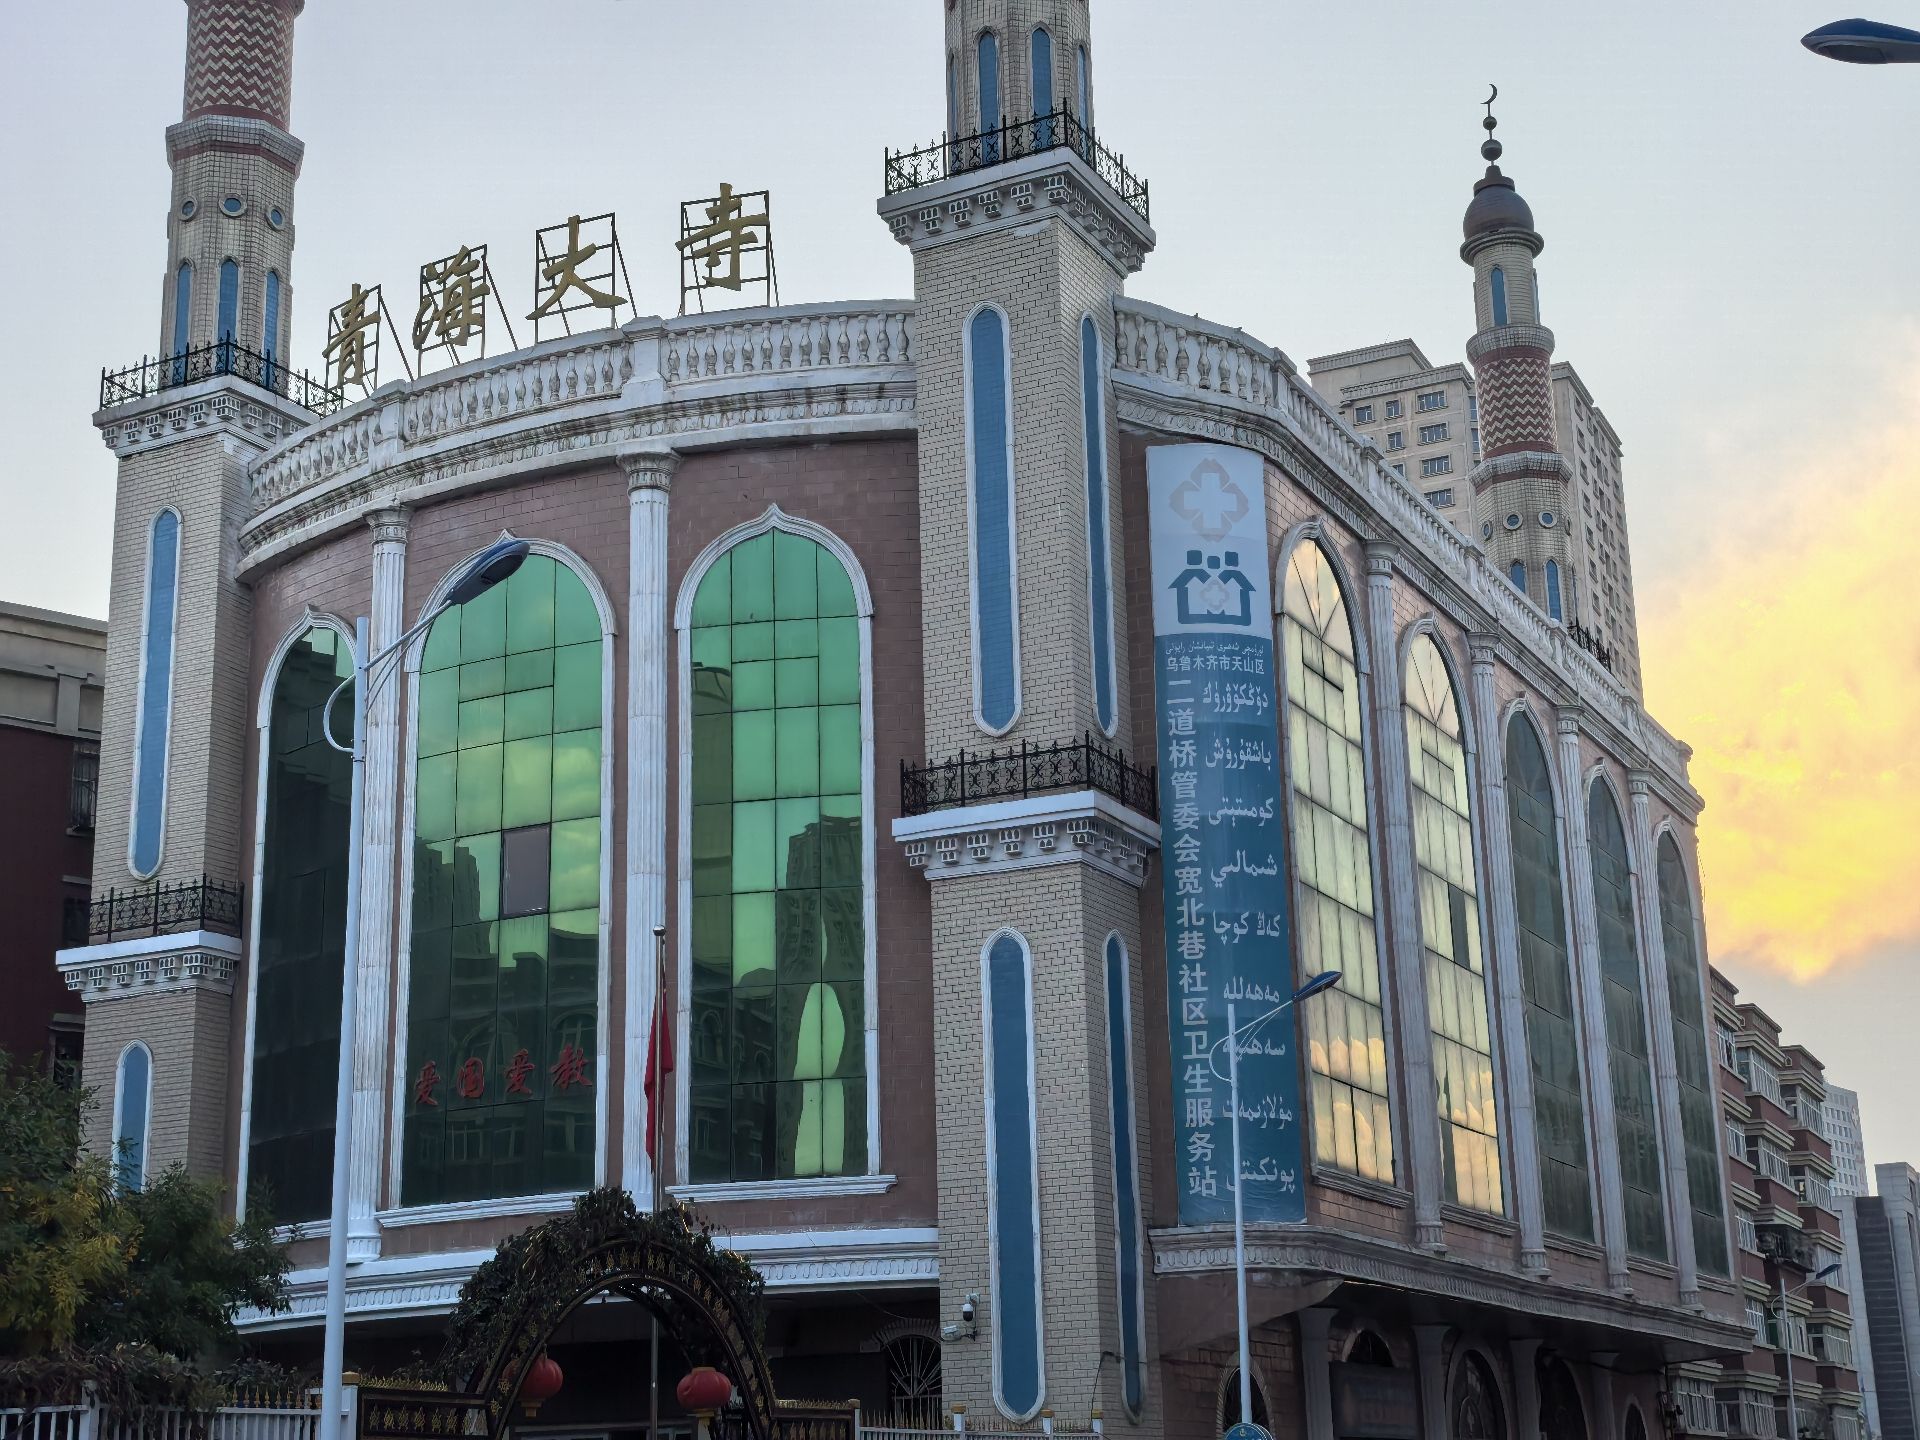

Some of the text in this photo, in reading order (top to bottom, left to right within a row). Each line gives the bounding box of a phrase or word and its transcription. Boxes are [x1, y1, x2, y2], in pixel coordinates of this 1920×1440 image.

[322, 182, 770, 386] 青海大寺
[1166, 655, 1265, 675] 乌鲁木齐市天山区
[1167, 679, 1217, 1197] 二道桥管委会宽北巷社区卫生服务站
[1213, 910, 1249, 945] كوچا
